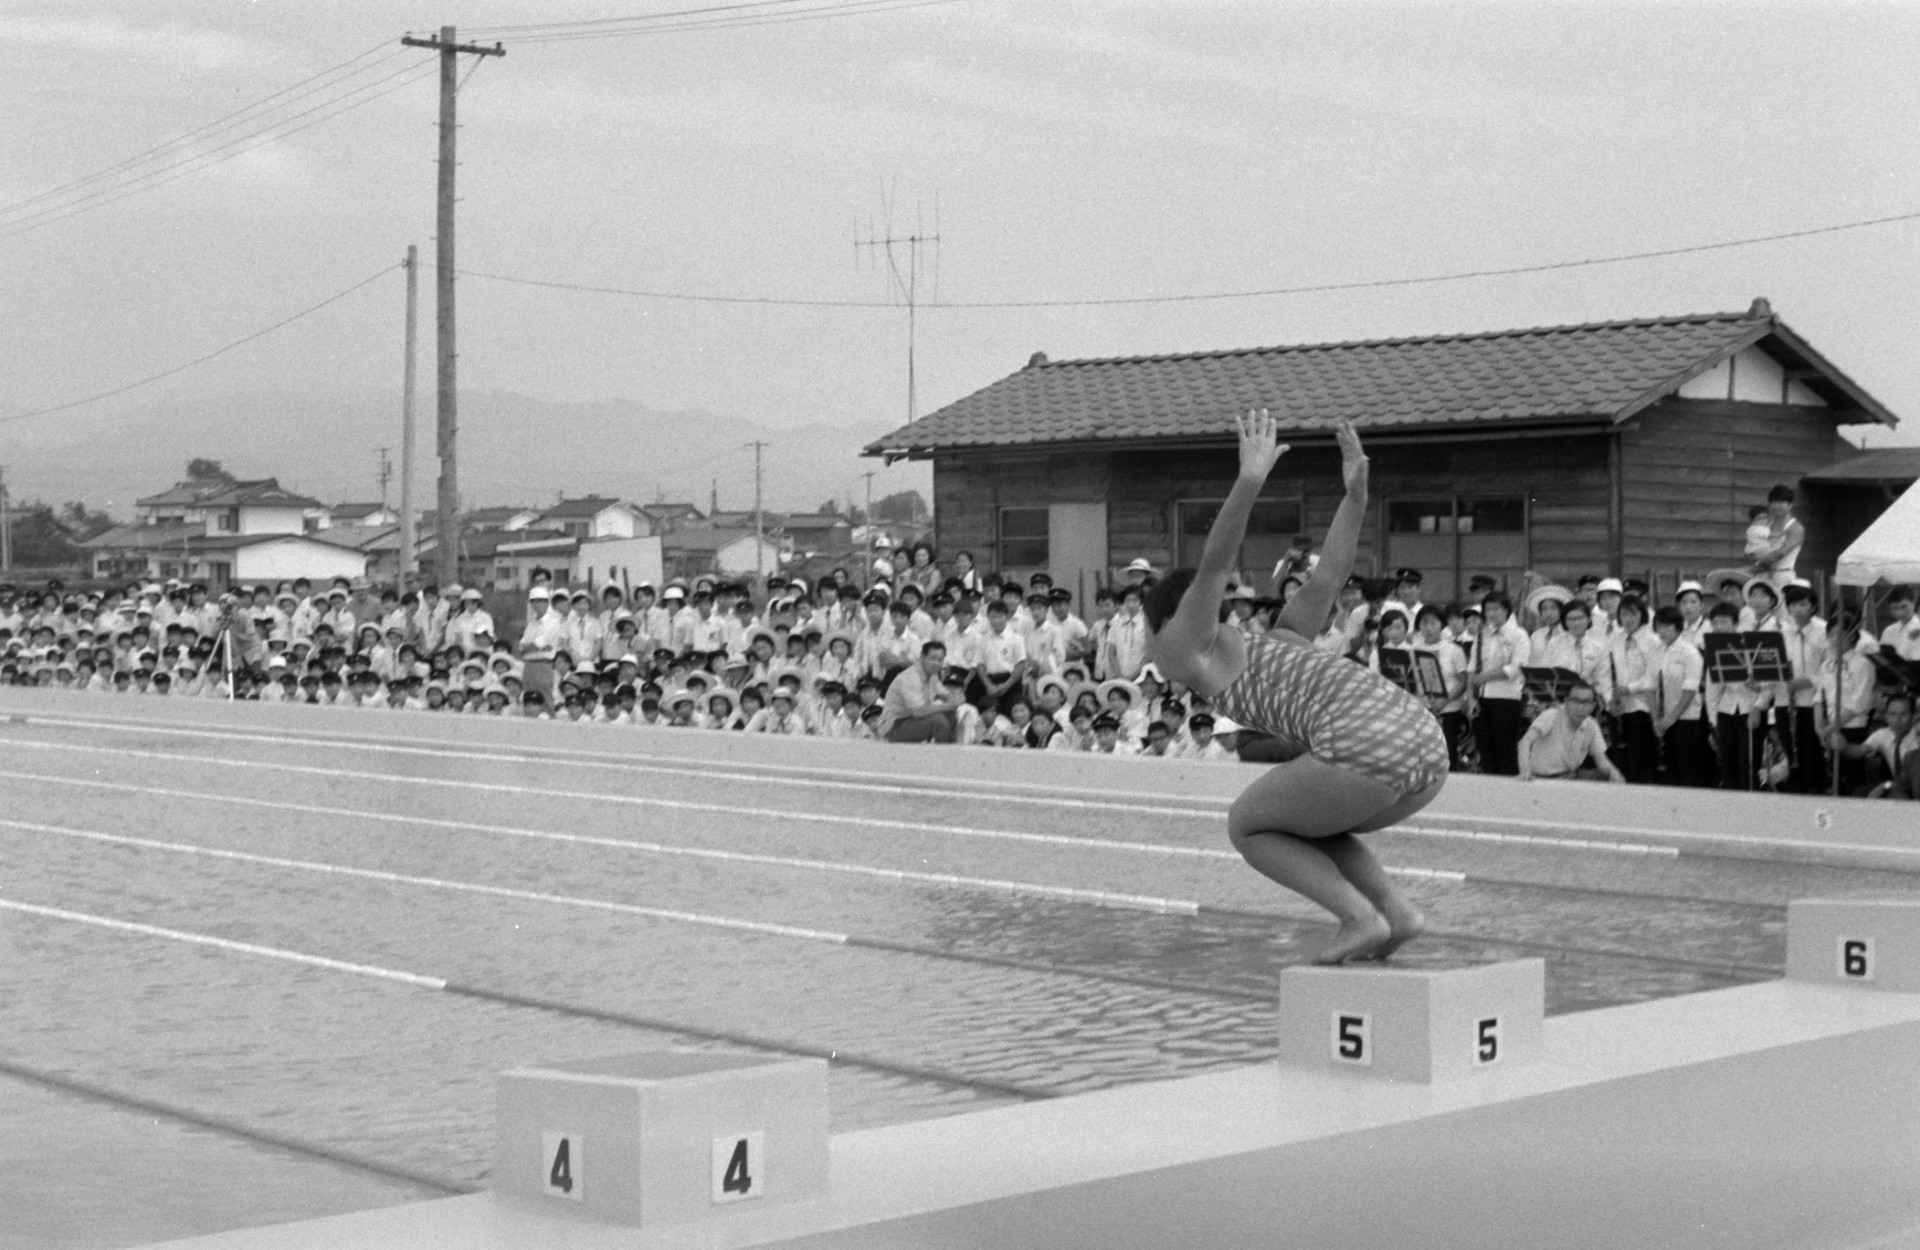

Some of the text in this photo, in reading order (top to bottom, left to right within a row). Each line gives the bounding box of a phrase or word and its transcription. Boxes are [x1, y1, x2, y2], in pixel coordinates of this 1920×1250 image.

[1844, 940, 1867, 977] 6
[1339, 1015, 1363, 1060] 5
[1478, 1018, 1498, 1062] 5
[550, 1138, 573, 1194] 4
[722, 1139, 752, 1194] 4
